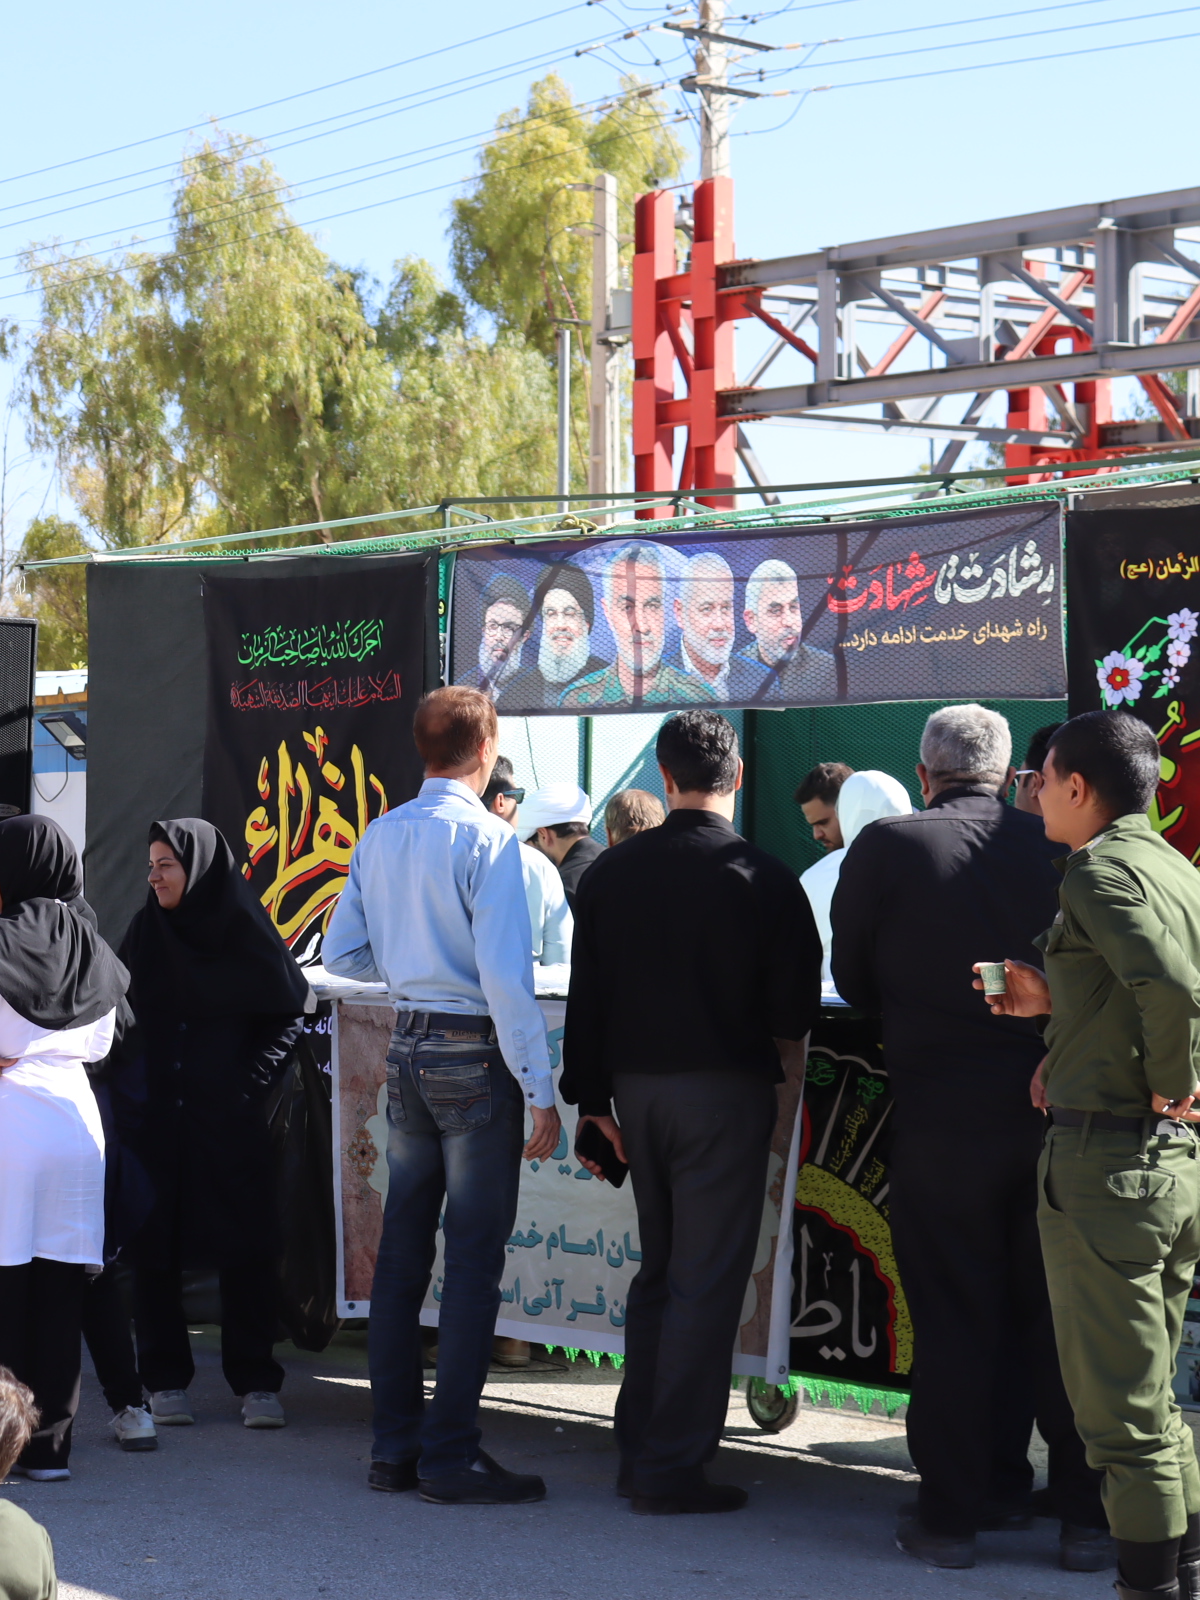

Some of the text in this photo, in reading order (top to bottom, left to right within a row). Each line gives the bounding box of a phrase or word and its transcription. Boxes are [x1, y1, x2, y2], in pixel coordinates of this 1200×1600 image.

[881, 625, 917, 645] ادامه
[920, 623, 970, 643] خدمت
[973, 619, 1024, 645] شهدای
[1027, 617, 1048, 641] راه
[504, 1220, 642, 1268] ان امام خمی
